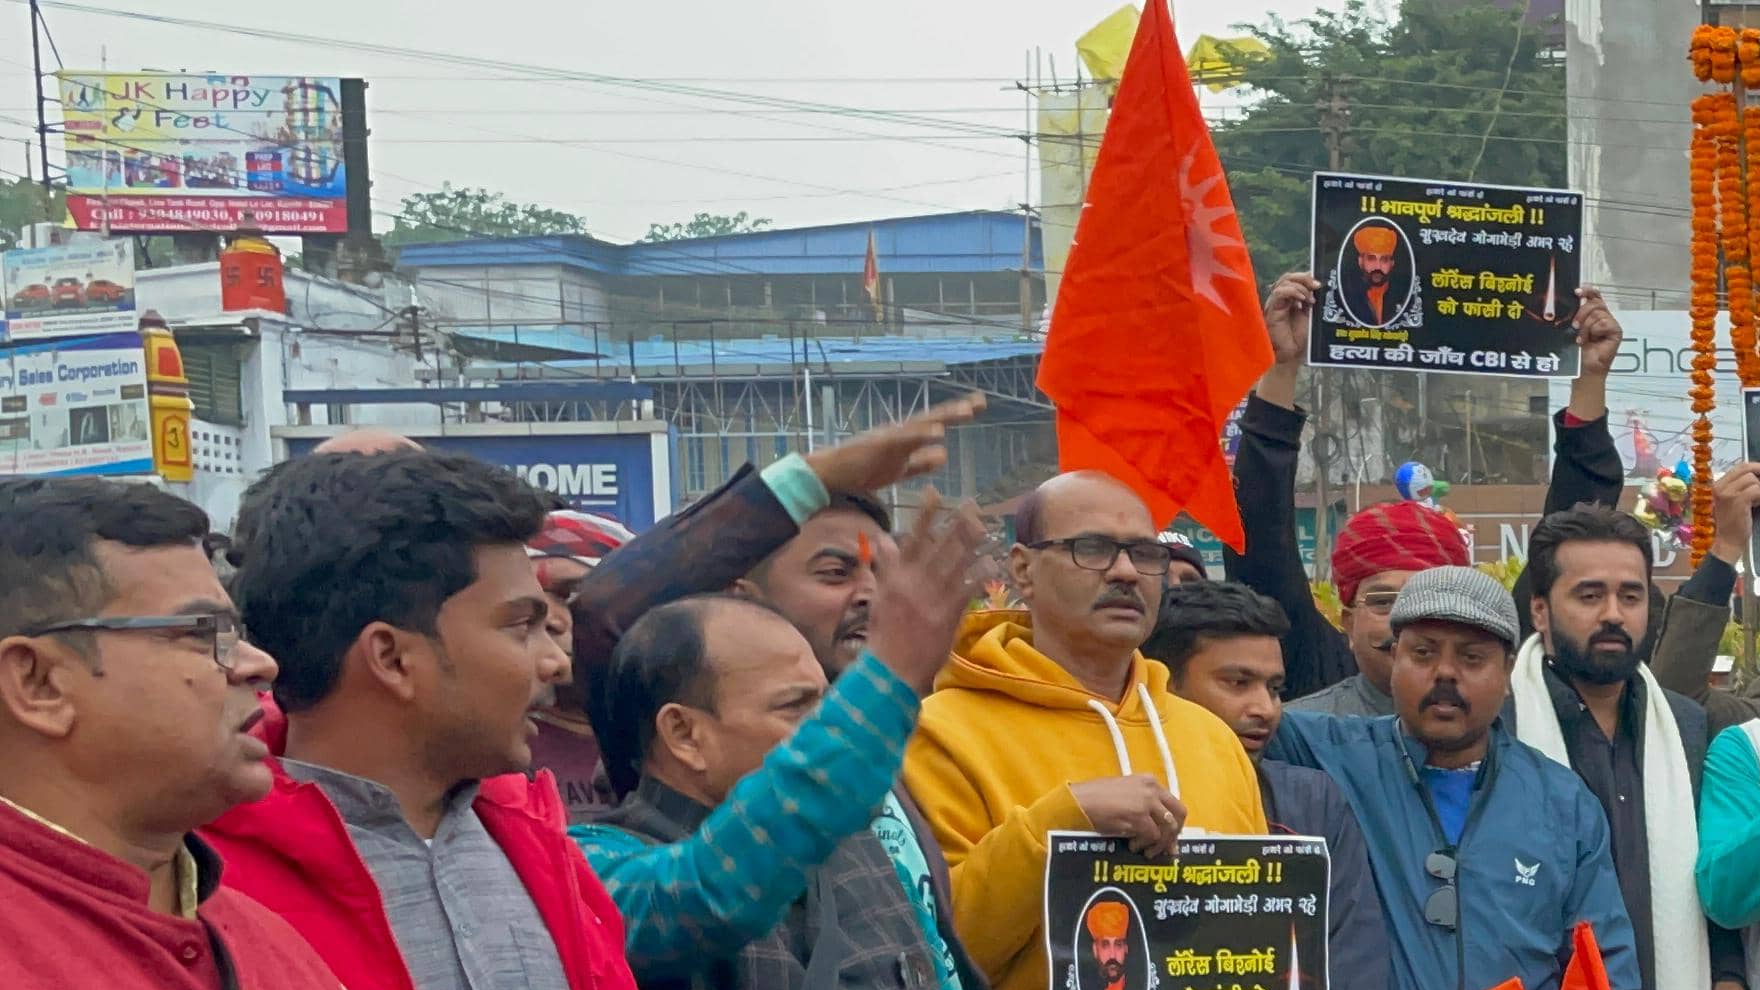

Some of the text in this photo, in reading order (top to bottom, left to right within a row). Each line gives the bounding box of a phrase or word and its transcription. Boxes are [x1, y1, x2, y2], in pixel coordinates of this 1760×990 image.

[111, 81, 271, 109] JK Happy
[1380, 197, 1443, 224] भावपूर्ण
[1446, 201, 1524, 224] श्रद्धांजली
[1437, 298, 1457, 315] को
[1507, 300, 1524, 321] दो
[58, 359, 138, 382] Corporation
[1329, 343, 1379, 362] हत्या
[1383, 343, 1413, 362] की
[1470, 351, 1506, 368] CBI
[1510, 351, 1531, 371] से
[1536, 352, 1560, 373] हो
[1113, 859, 1179, 893] भावपूर्ण
[1182, 859, 1261, 885] श्रद्धांजली
